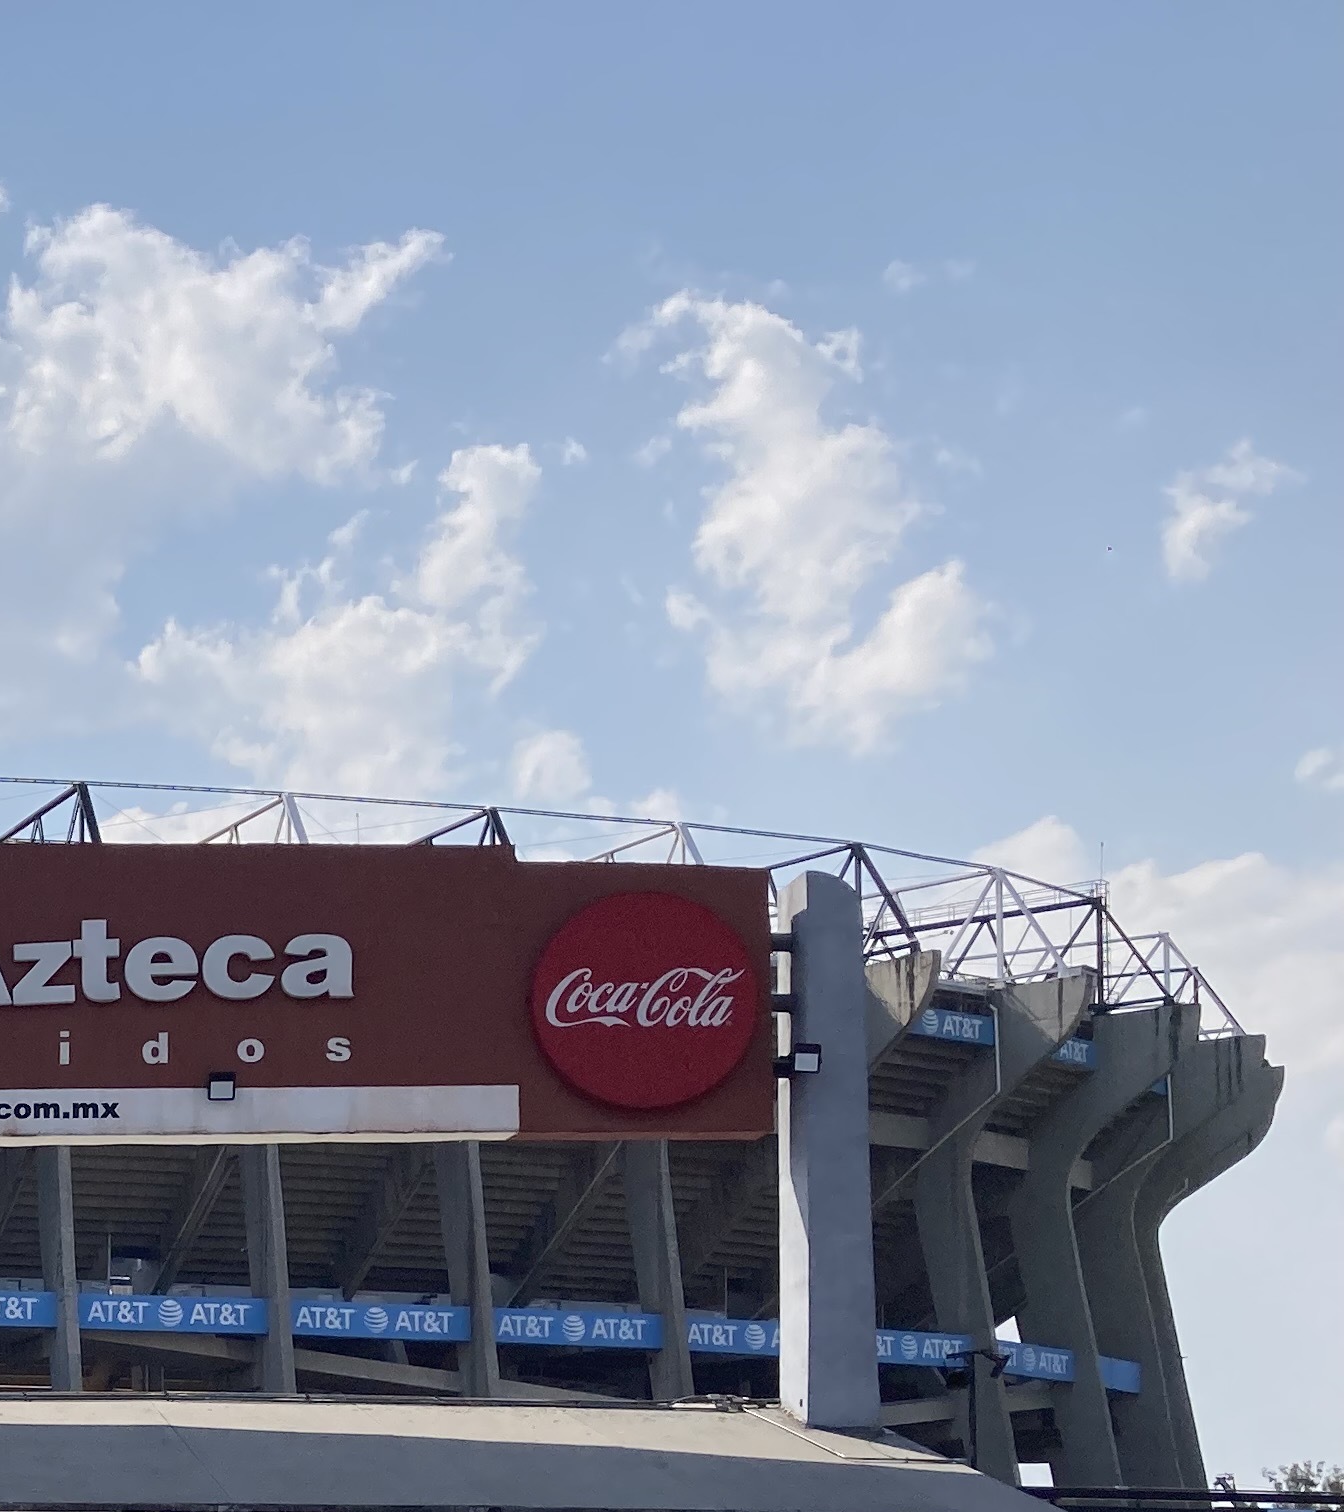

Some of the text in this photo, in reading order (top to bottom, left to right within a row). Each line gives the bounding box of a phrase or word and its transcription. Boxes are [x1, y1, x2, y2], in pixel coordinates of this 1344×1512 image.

[546, 967, 745, 1027] Coca-Cola
[943, 1015, 983, 1040] AT&T
[88, 1300, 250, 1326] AT&T AT&T
[296, 1306, 453, 1334] AT&T AT&T
[498, 1315, 646, 1341] AT&T AT&T
[688, 1323, 737, 1346] AT&T
[1039, 1352, 1069, 1375] AT&T
